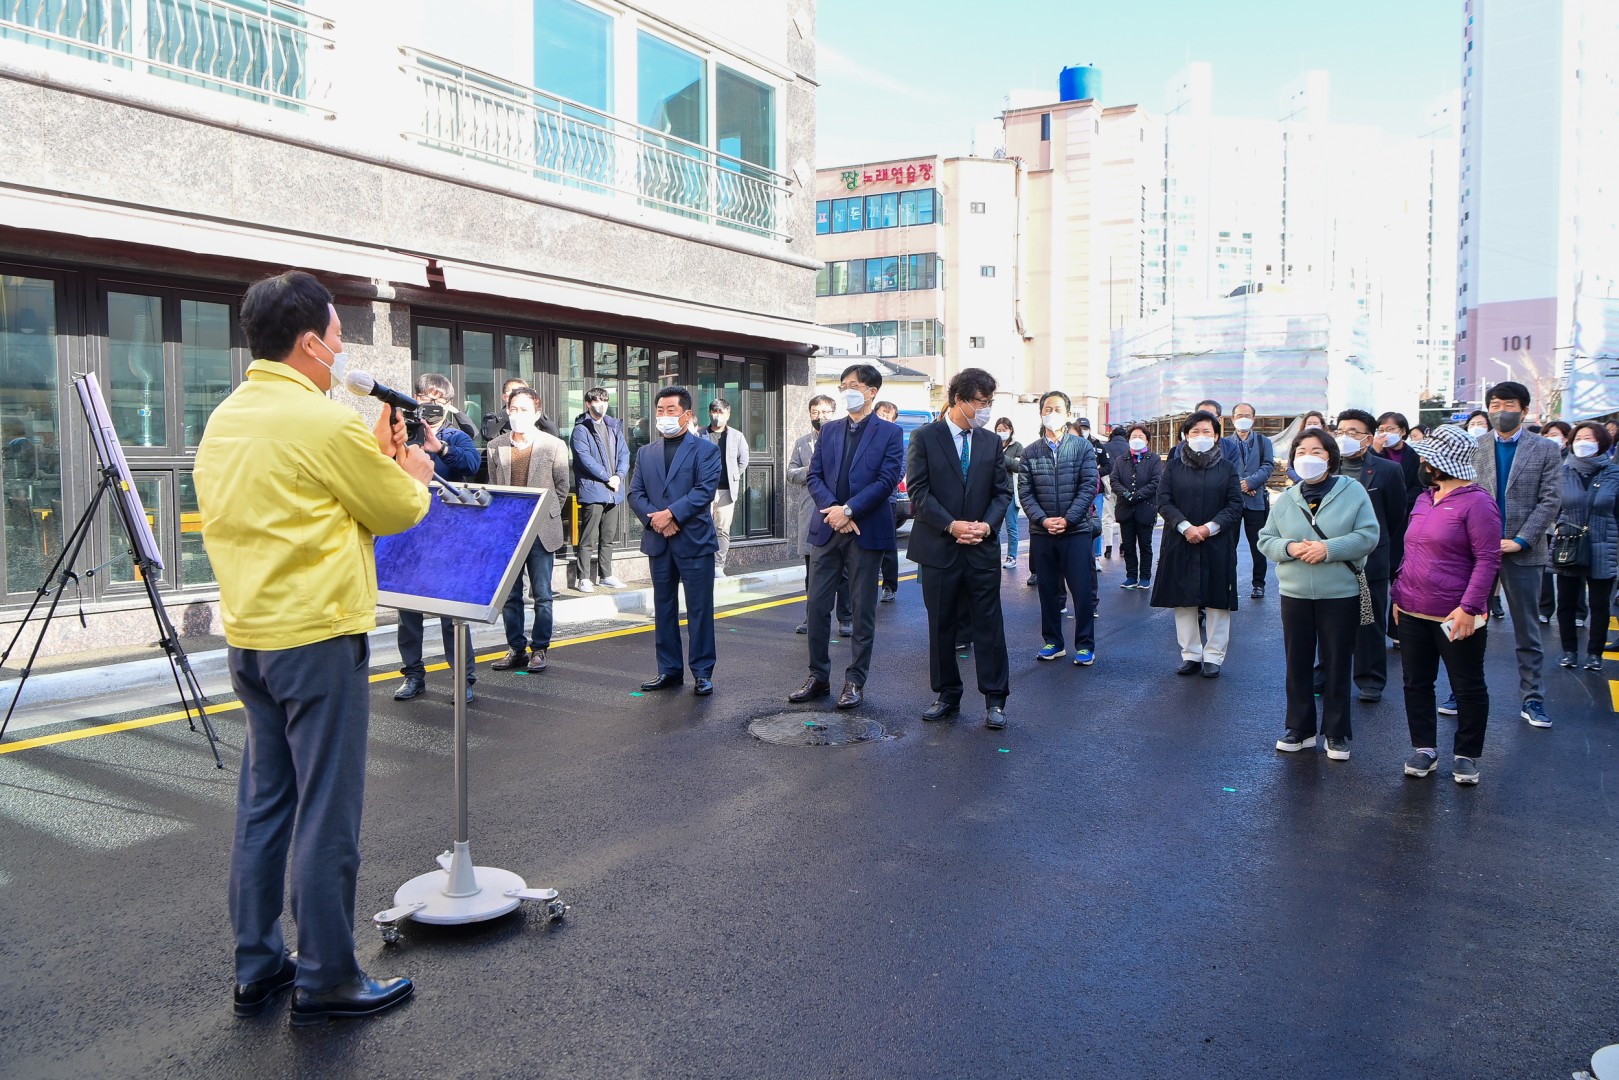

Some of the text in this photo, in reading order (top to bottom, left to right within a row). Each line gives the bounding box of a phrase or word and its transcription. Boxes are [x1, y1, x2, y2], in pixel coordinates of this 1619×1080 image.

[841, 163, 932, 190] 짱 노래연습장
[1502, 335, 1532, 351] 101
